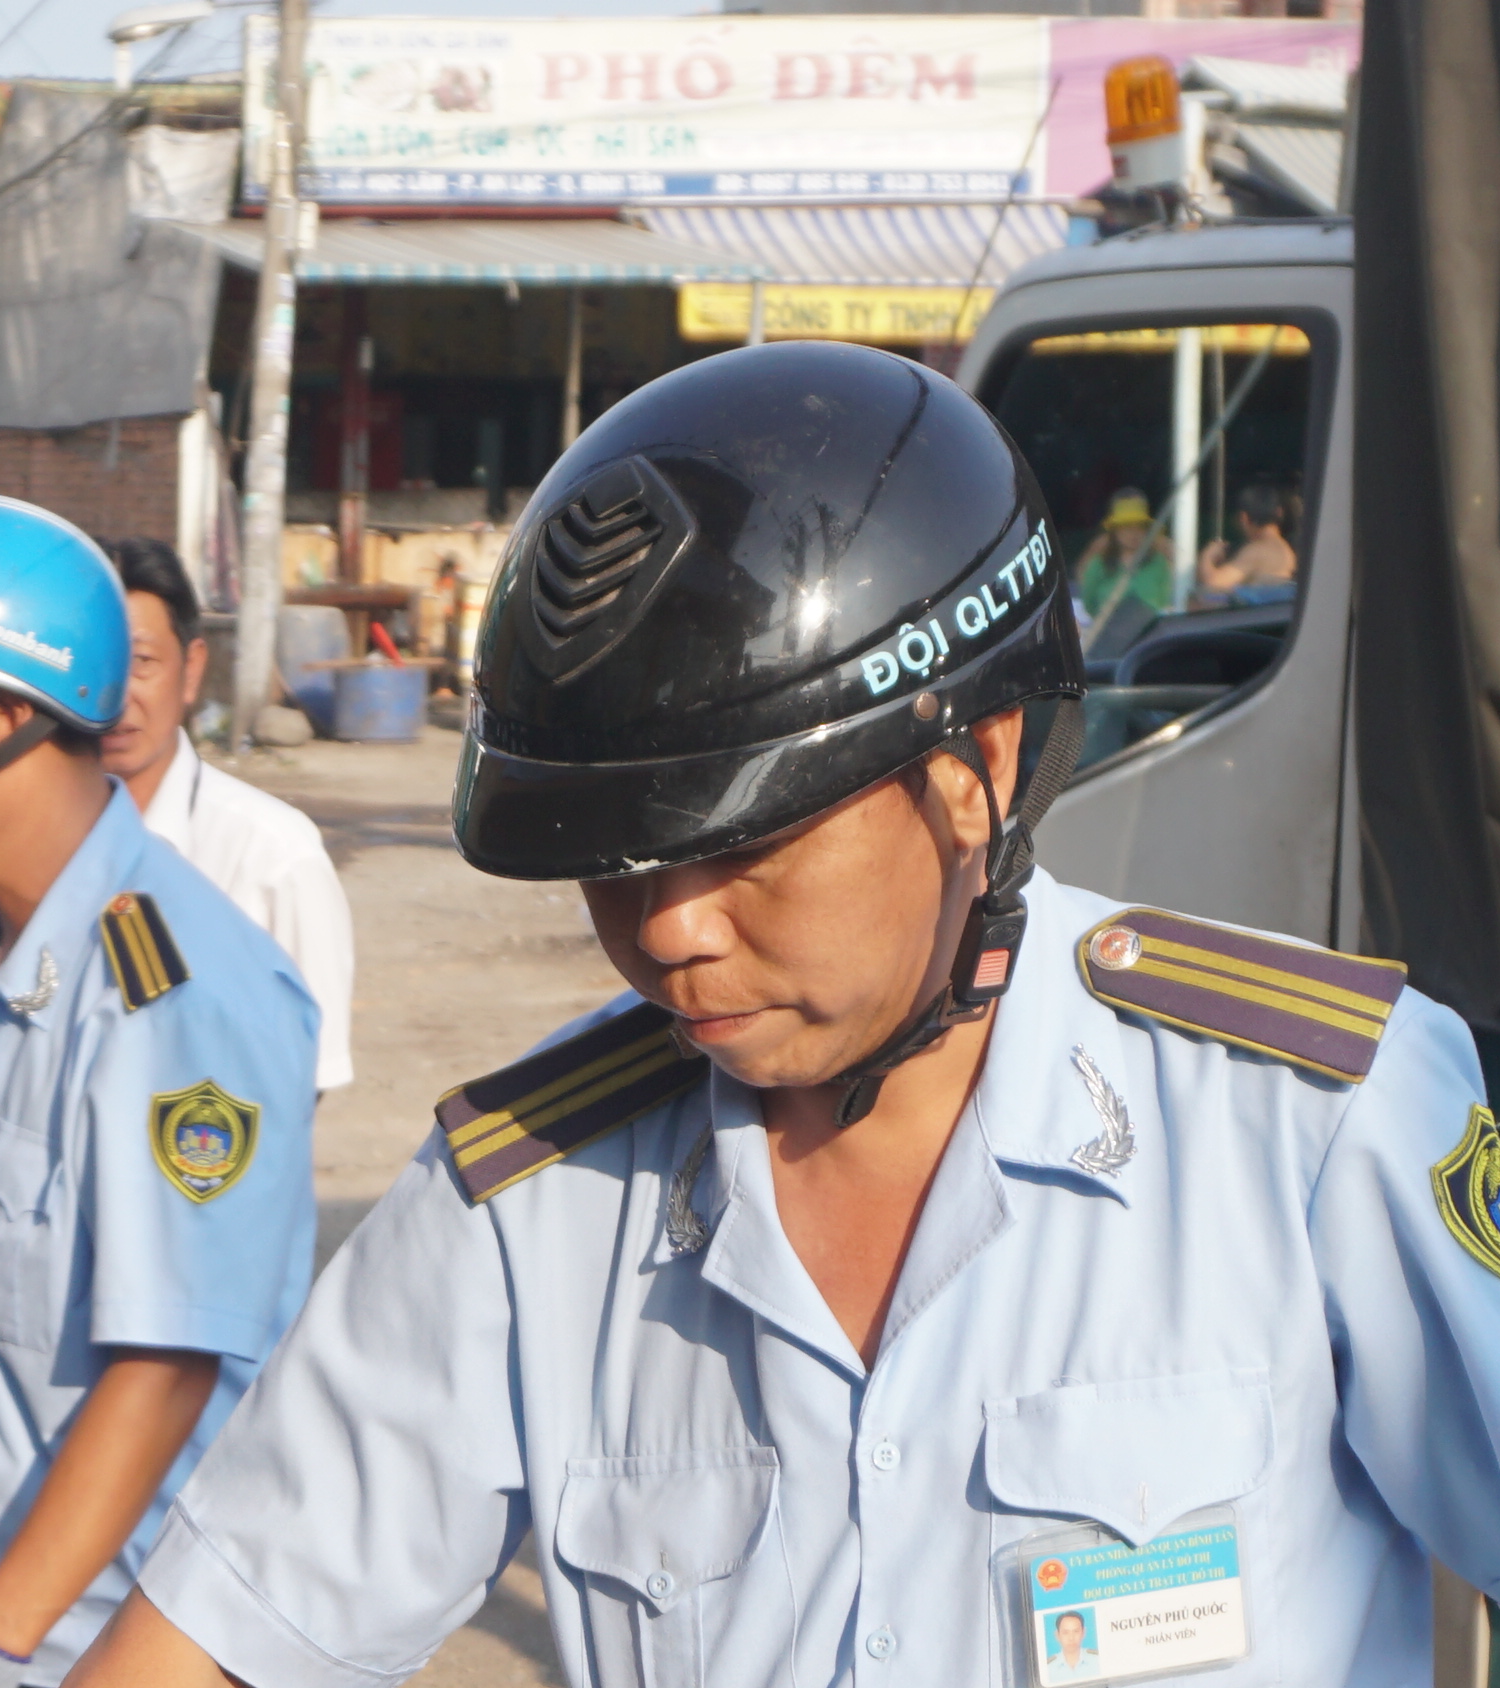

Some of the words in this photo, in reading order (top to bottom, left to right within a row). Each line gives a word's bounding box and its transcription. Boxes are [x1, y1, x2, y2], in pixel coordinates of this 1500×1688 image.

[539, 24, 736, 101] PHỐ
[860, 621, 950, 696] ĐỘI
[954, 518, 1052, 634] QLTTĐT
